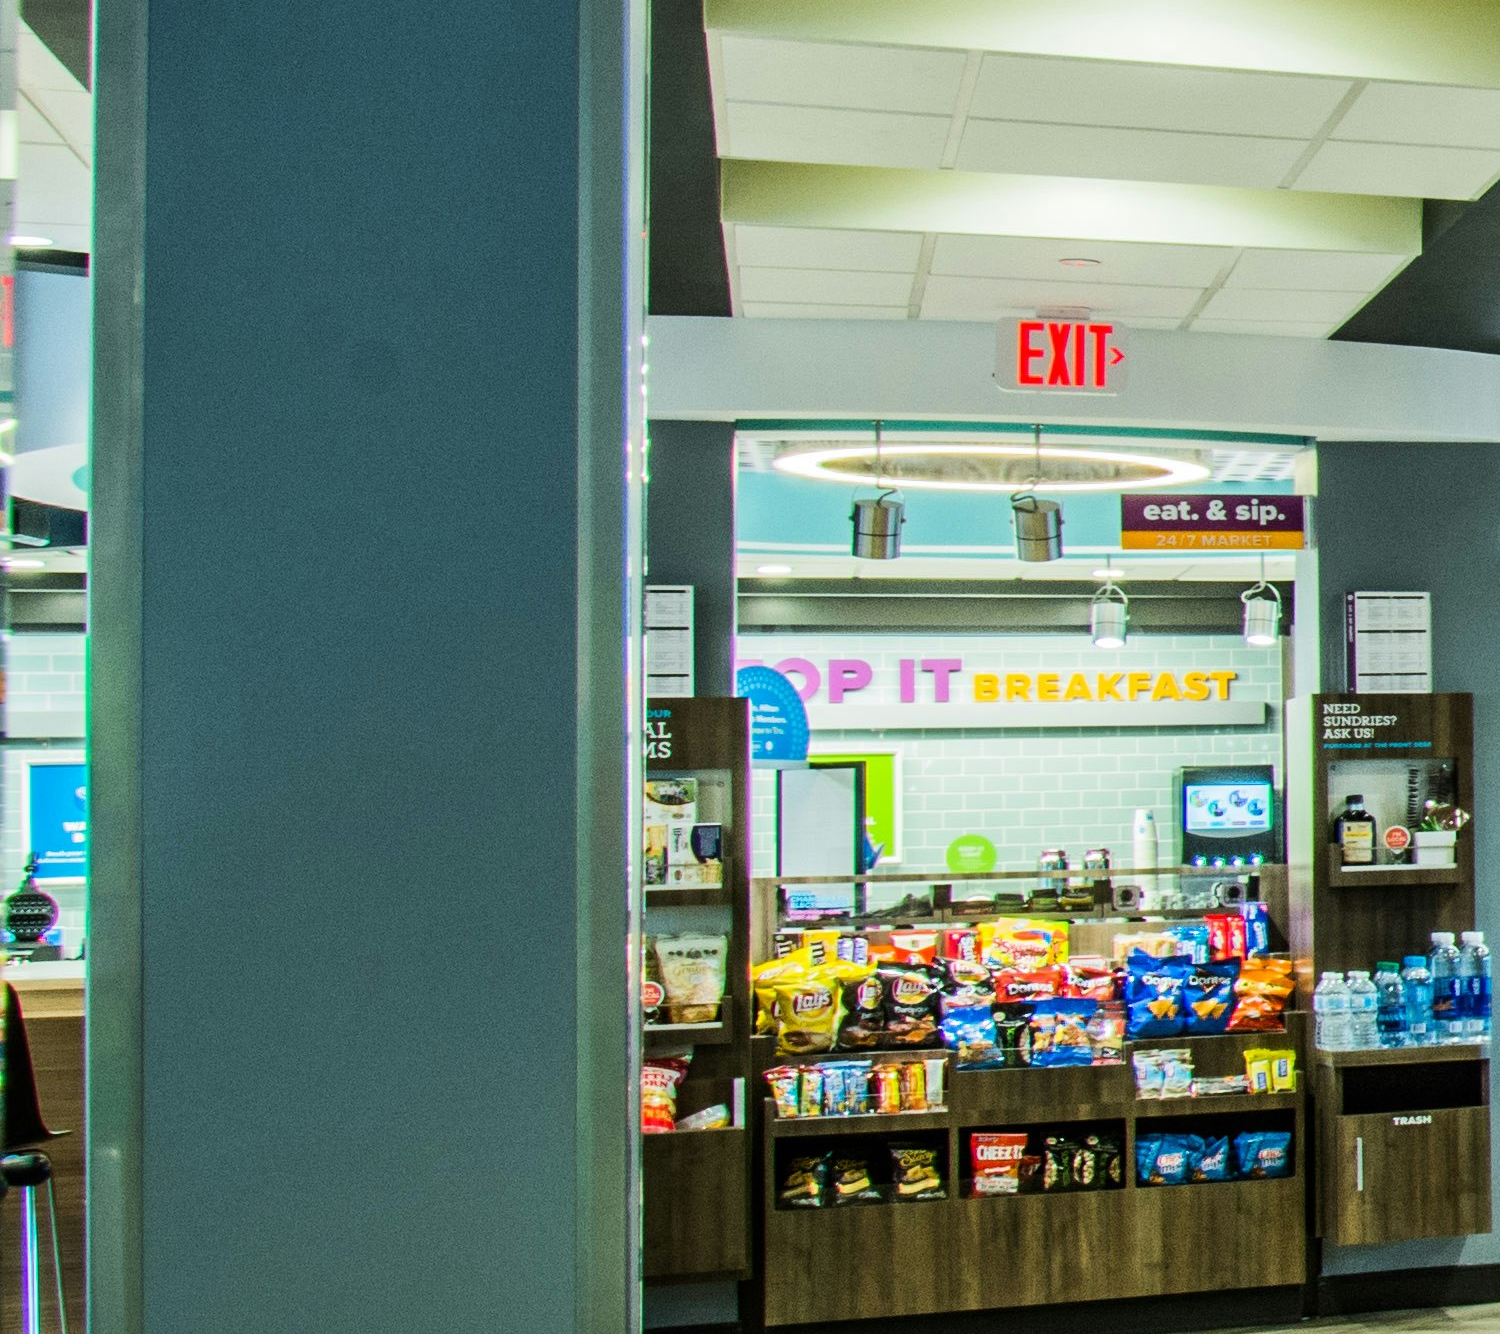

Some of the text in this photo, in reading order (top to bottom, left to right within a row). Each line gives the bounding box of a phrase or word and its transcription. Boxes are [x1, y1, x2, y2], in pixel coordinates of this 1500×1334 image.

[1017, 321, 1112, 387] EXIT
[1143, 498, 1286, 526] eat. & sip.
[1156, 534, 1272, 547] 24/7 MARKET
[735, 657, 1236, 704] OP IT BREAKFAST
[1323, 703, 1360, 714] NEED
[1323, 715, 1397, 727] SUNDRIES?
[1324, 728, 1375, 739] ASK US!
[1188, 974, 1232, 986] Doritos
[1007, 981, 1054, 995] Doritos
[1393, 1115, 1432, 1126] TRASH
